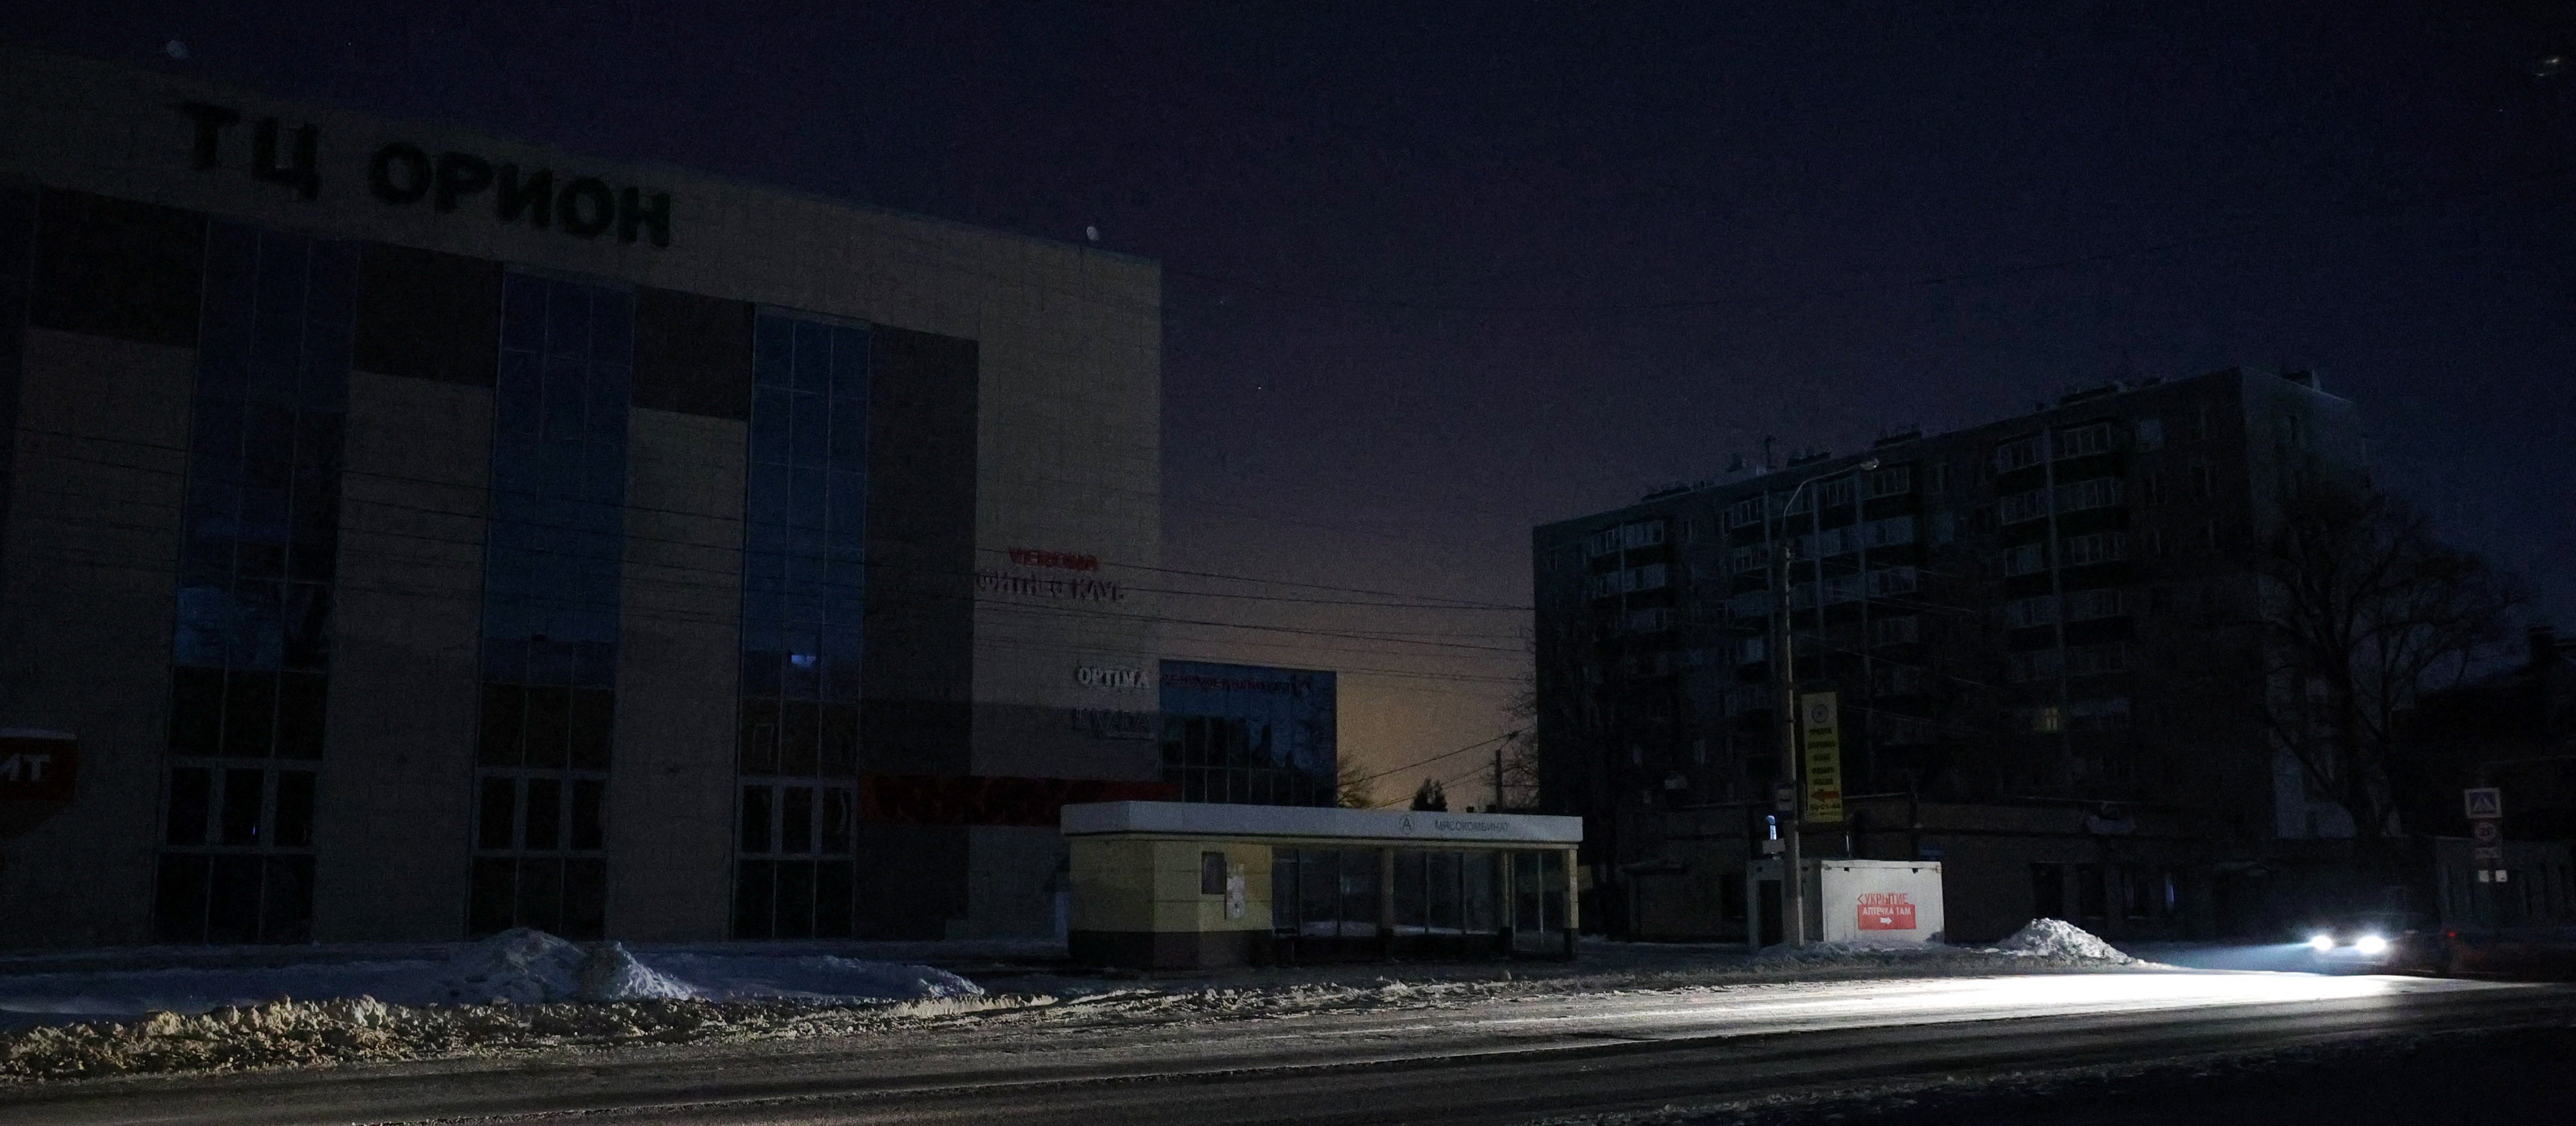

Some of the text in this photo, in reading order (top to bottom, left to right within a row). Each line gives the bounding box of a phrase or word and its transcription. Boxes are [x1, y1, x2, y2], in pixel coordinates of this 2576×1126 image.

[181, 100, 671, 248] ТЦ ОРИОН
[1435, 819, 1510, 833] МЯСОКОМБИНАТ
[1864, 893, 1909, 906] УКРЫТИЕ
[1862, 907, 1911, 916] АПТЕЧКА ТАМ
